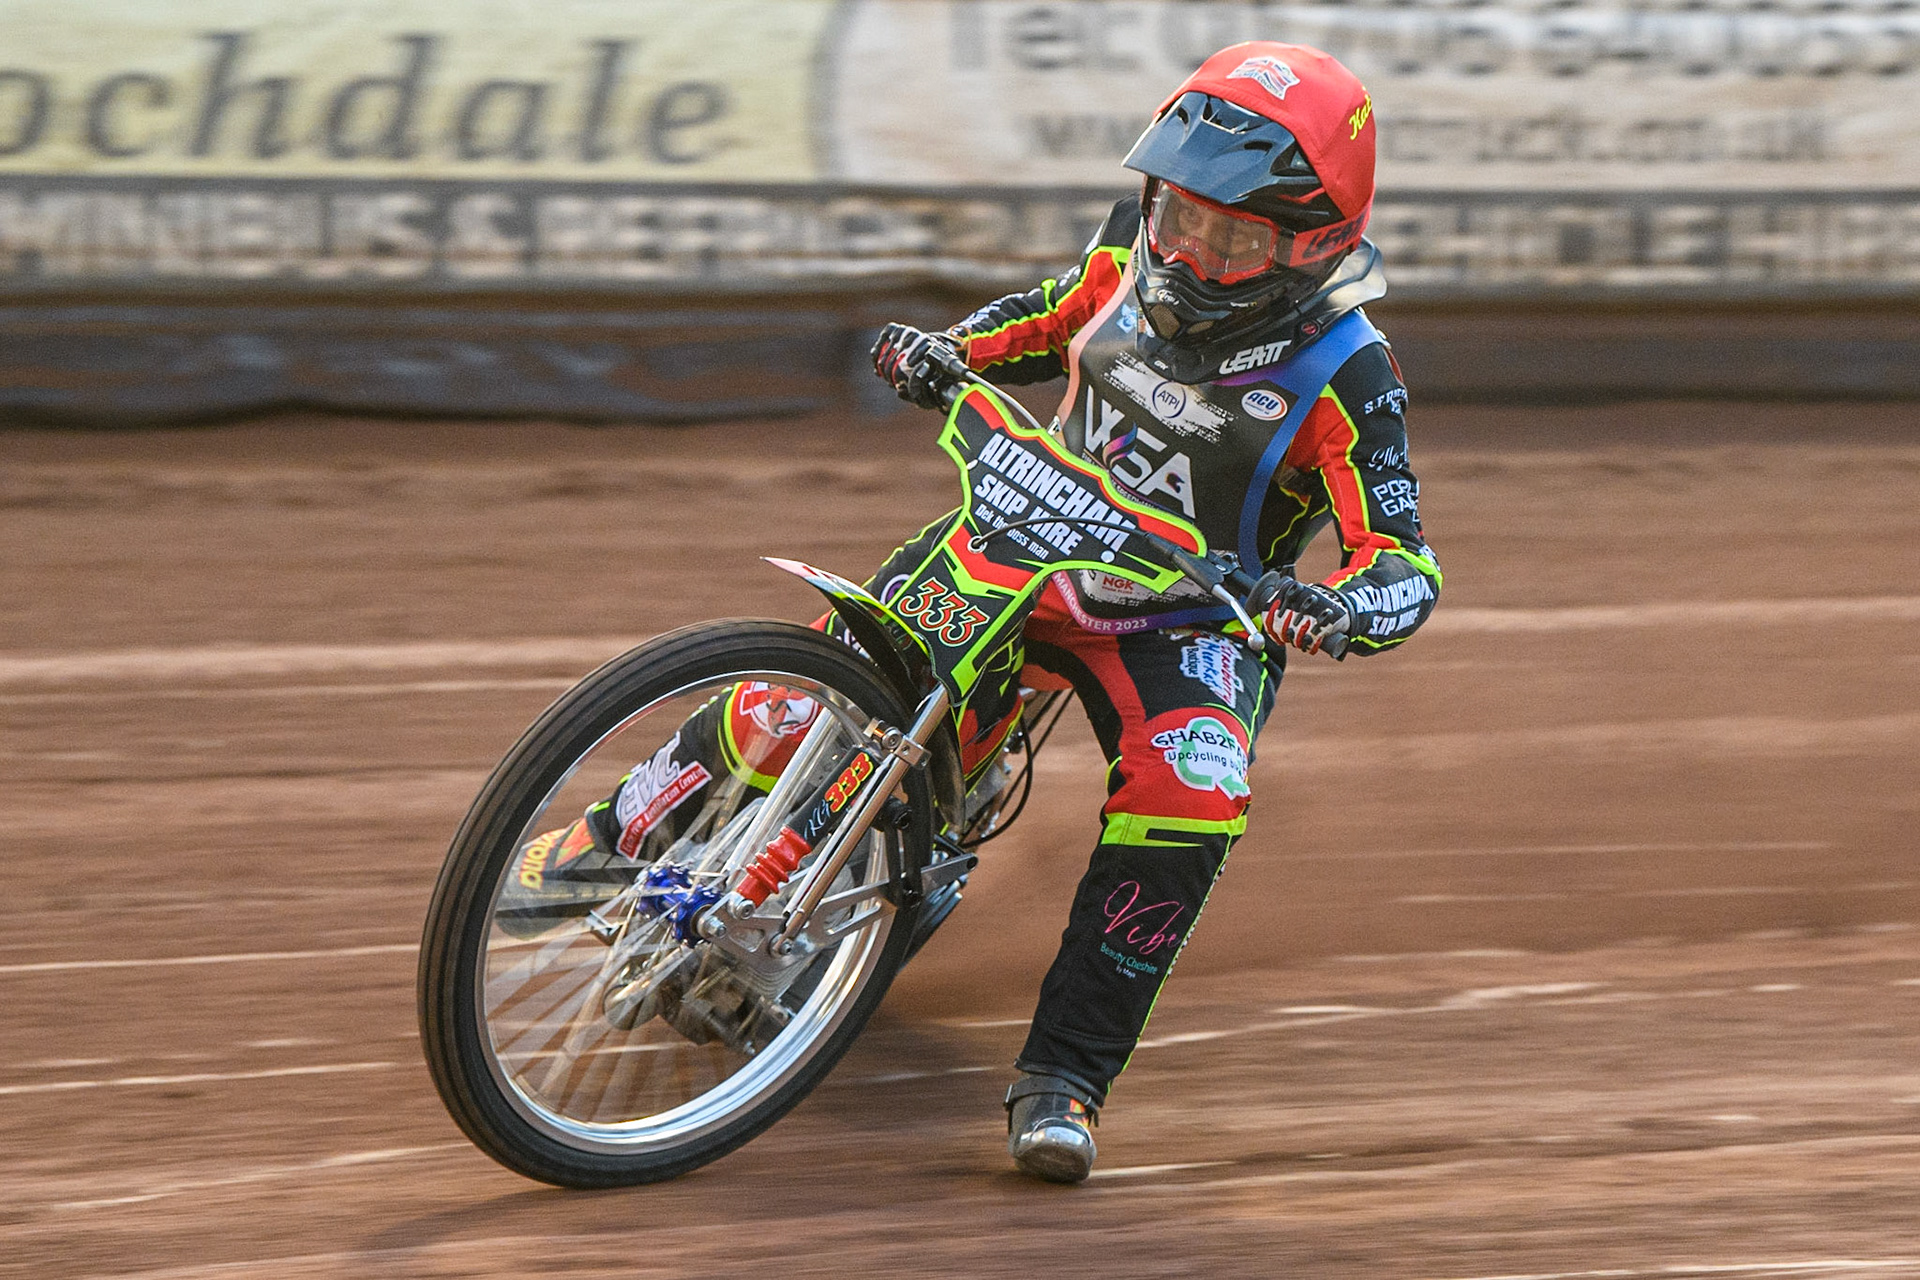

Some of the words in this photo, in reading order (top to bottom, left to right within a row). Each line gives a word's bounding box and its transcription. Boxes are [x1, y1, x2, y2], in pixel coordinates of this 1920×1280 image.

[1156, 389, 1180, 411] ATPI
[1247, 391, 1280, 411] ACU
[974, 474, 1029, 516] SKIP
[1026, 505, 1084, 557] HIRE
[978, 432, 1136, 552] ALTRINCHAM
[974, 503, 994, 523] Dek
[1027, 541, 1049, 560] man
[1054, 572, 1112, 631] MANCHESTER
[1115, 619, 1148, 631] 2023
[1103, 575, 1134, 590] NGK
[897, 577, 990, 647] 333
[824, 752, 873, 813] 333
[1168, 751, 1227, 767] Upcycling
[1100, 942, 1125, 966] Beauty
[1126, 956, 1158, 975] Cheshire
